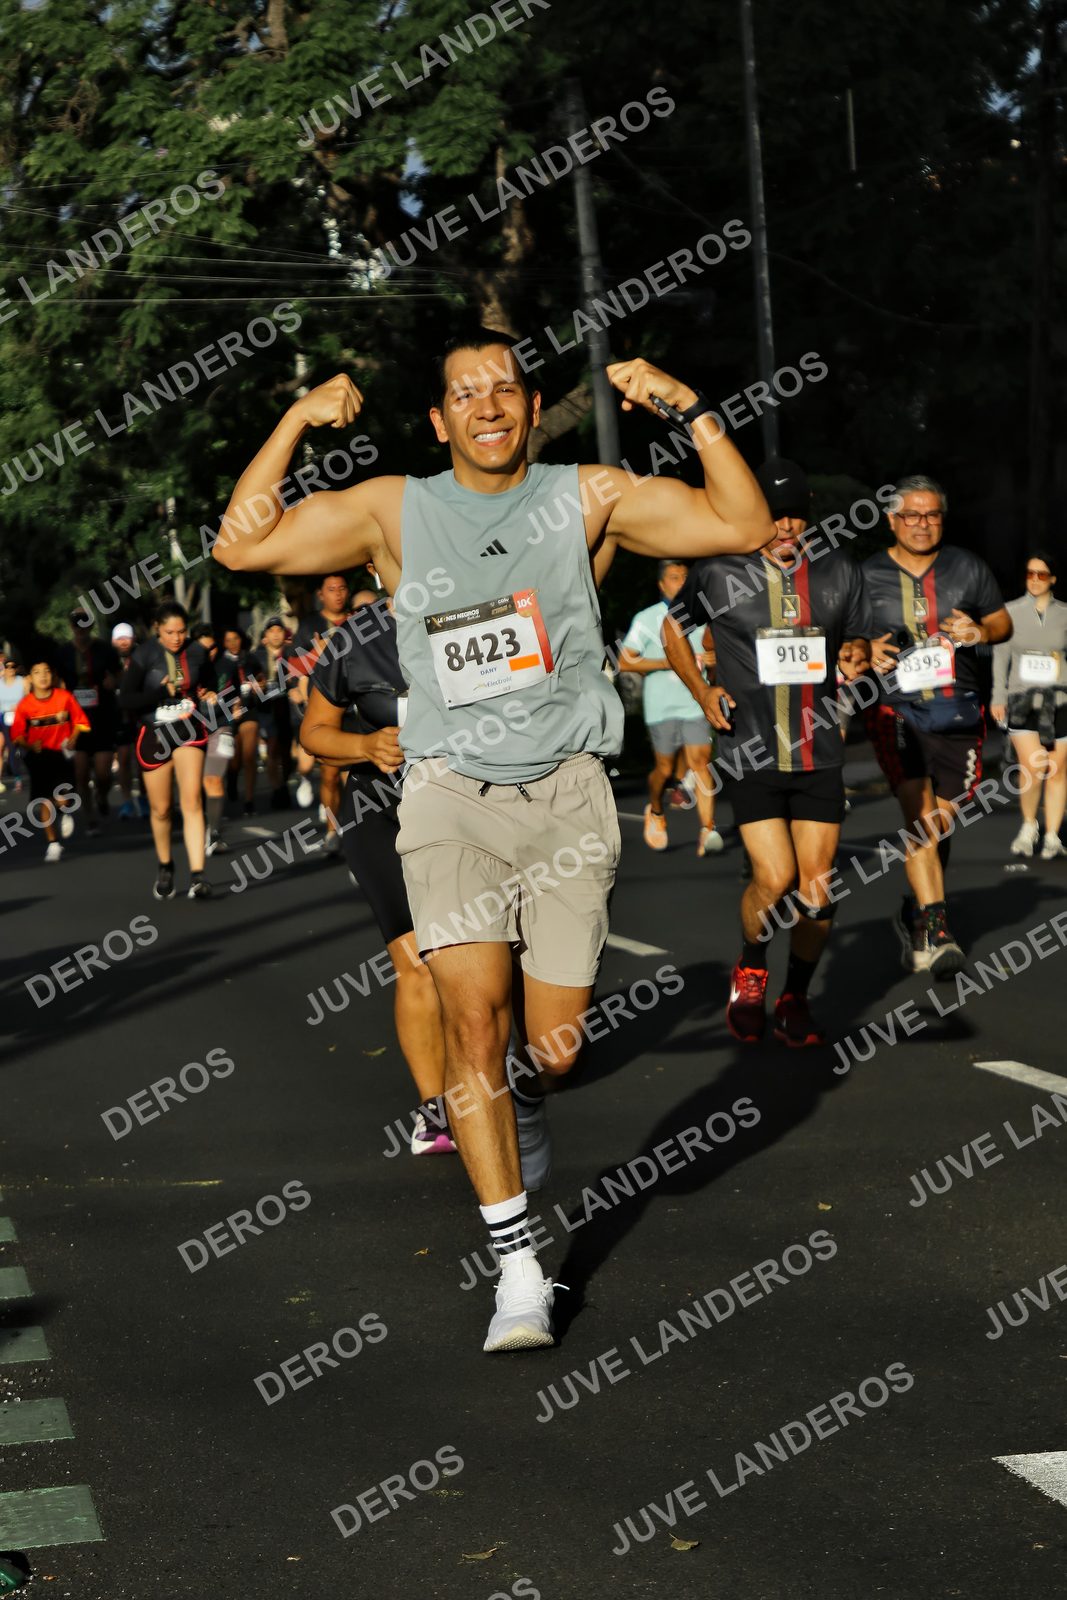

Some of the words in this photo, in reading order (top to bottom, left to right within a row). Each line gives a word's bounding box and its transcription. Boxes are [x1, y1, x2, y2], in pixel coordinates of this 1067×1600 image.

[444, 628, 521, 672] 8423
[777, 645, 809, 663] 918
[903, 653, 942, 673] 8395
